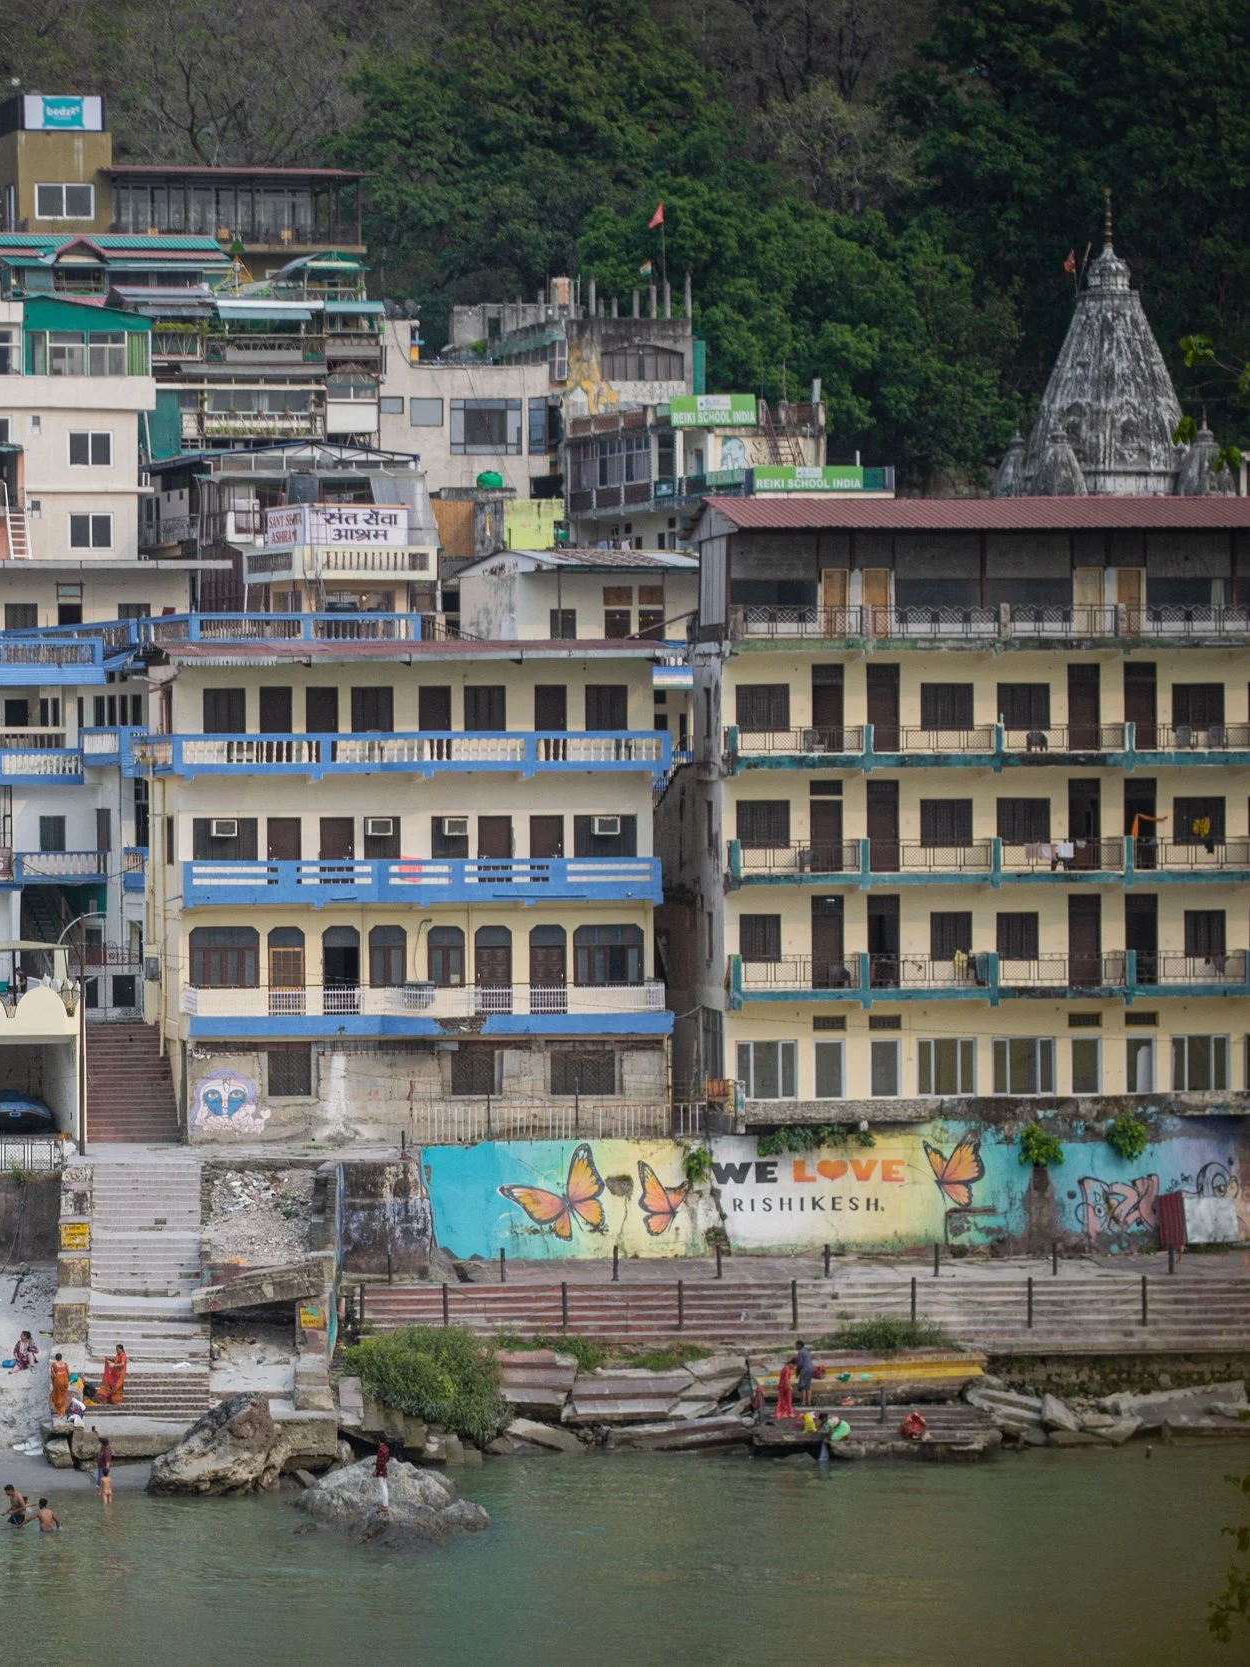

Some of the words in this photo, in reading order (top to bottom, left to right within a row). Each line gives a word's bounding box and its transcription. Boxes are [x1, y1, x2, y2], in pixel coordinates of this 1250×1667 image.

[672, 412, 695, 423] REIKI
[698, 411, 731, 422] SCHOOL
[733, 411, 755, 422] INDIA
[756, 479, 784, 488] REIKI
[788, 479, 830, 488] SCHOOL
[833, 479, 861, 488] INDIA
[324, 508, 358, 526] संत
[332, 528, 388, 542] आश्रम
[712, 1161, 778, 1184] WE
